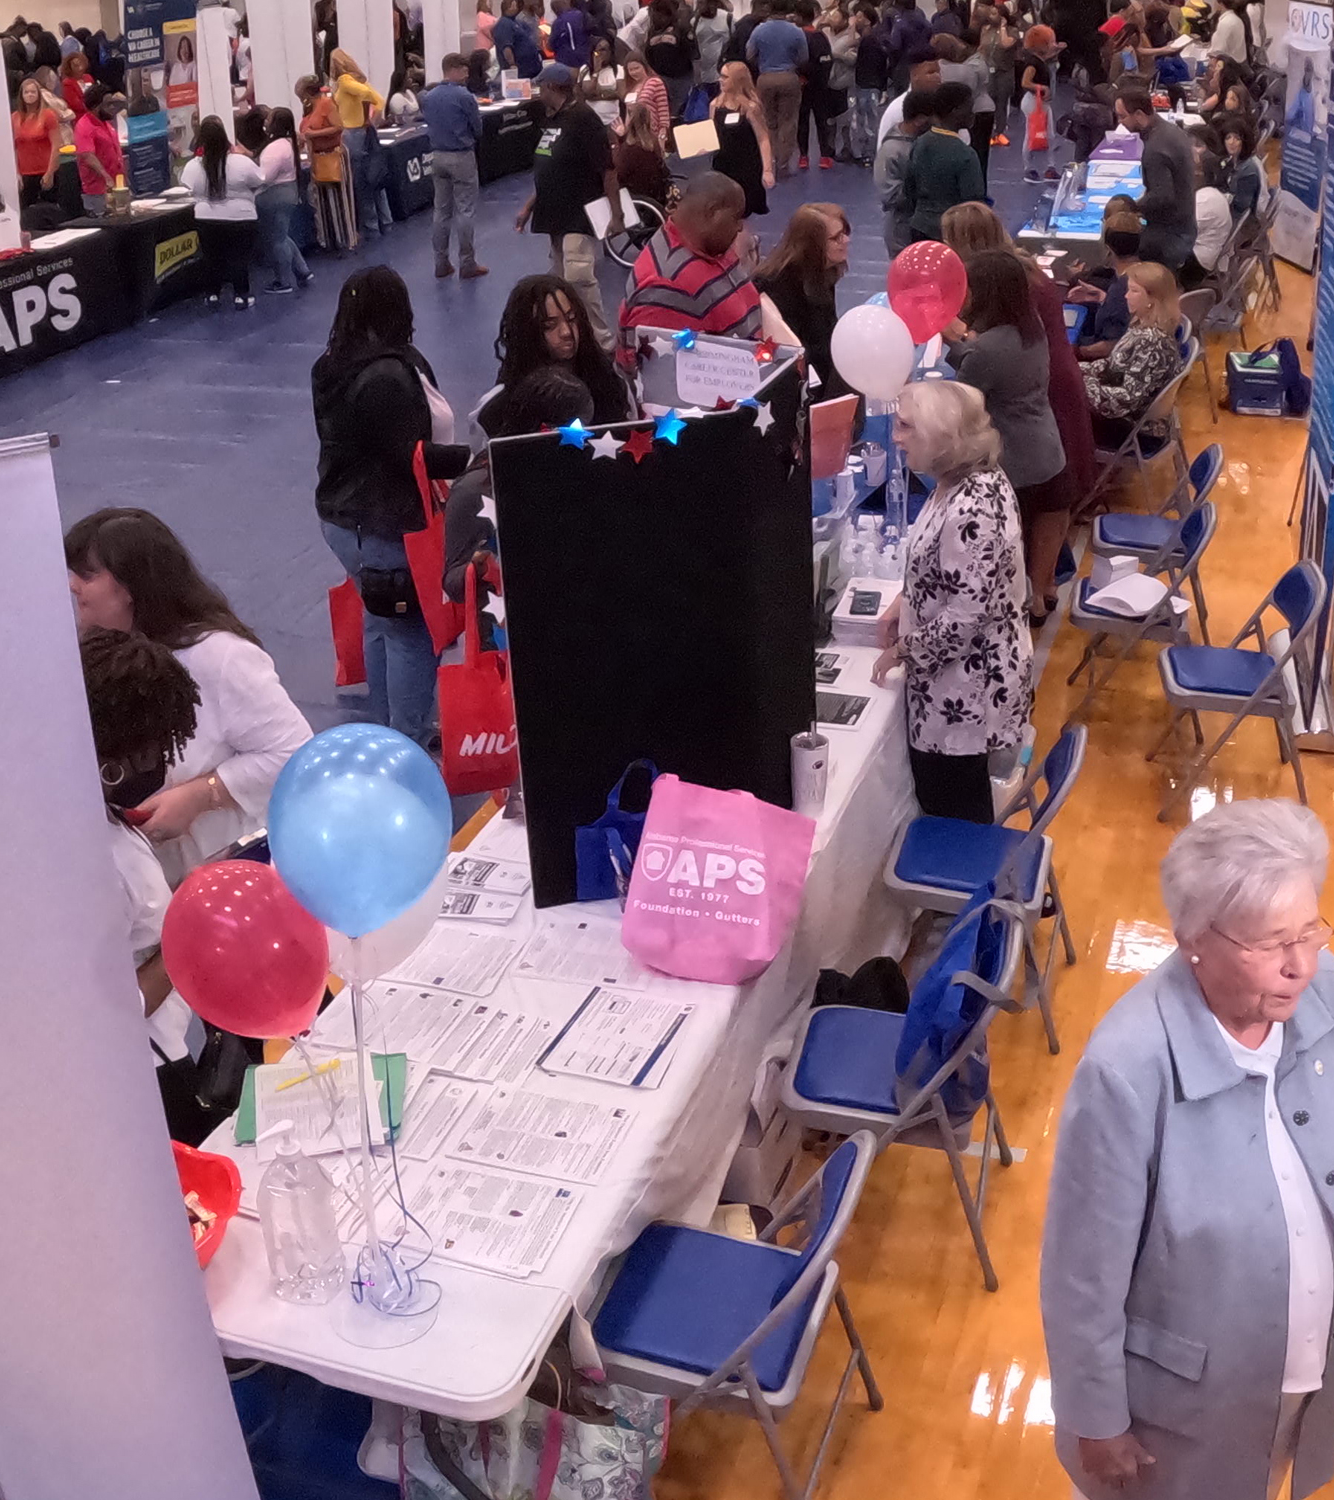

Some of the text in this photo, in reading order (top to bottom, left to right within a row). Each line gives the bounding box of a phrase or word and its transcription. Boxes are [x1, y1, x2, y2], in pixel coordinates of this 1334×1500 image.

[159, 238, 193, 265] DOLLAR
[36, 257, 74, 276] Services
[667, 849, 766, 895] APS
[669, 887, 729, 903] EST. 1977
[633, 900, 760, 926] Foundation Gutters
